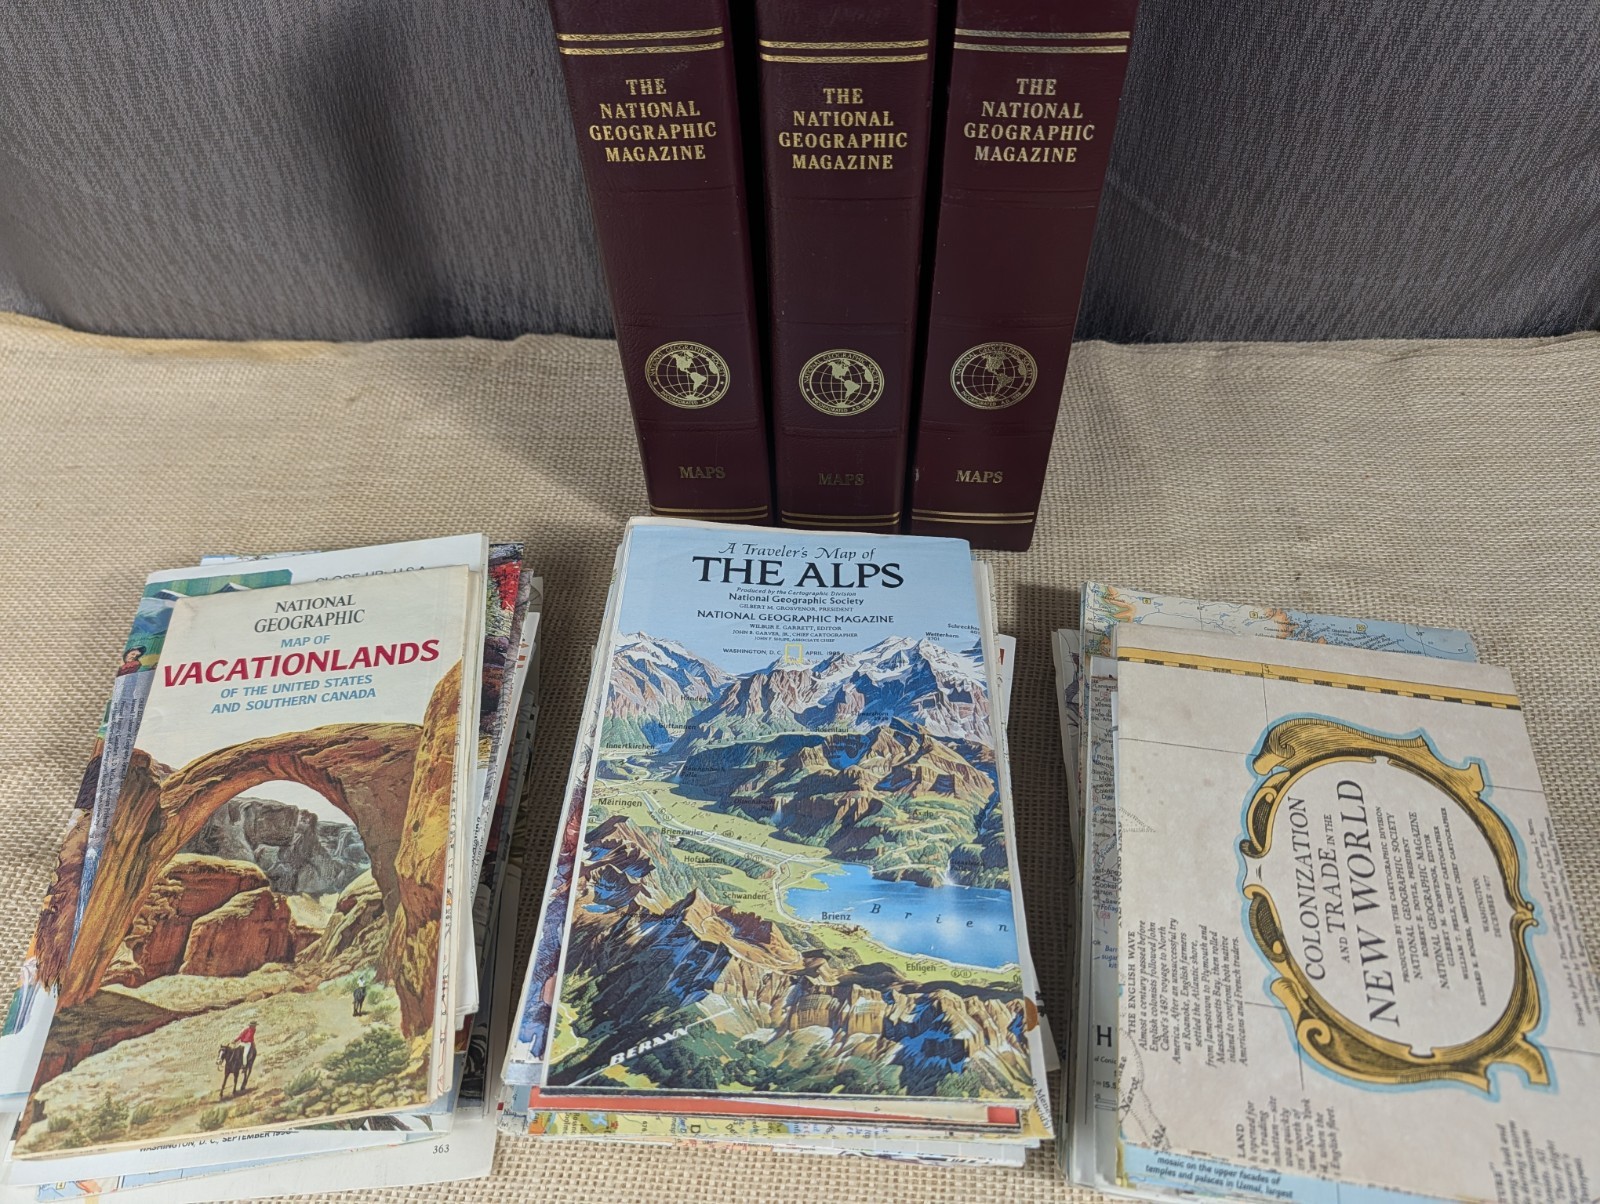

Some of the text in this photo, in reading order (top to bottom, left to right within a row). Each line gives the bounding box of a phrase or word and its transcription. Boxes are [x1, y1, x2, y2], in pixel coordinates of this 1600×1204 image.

[626, 79, 666, 95] THE
[823, 88, 863, 104] THE
[1016, 78, 1057, 96] THE
[599, 101, 700, 119] NATIONAL
[793, 111, 894, 127] NATIONAL
[981, 101, 1083, 119] NATIONAL
[589, 121, 717, 141] GEOGRAPHIC
[779, 132, 908, 149] GEOGRAPHIC
[963, 122, 1095, 141] GEOGRAPHIC
[605, 144, 706, 162] MAGAZINE
[792, 154, 893, 170] MAGAZINE
[974, 145, 1077, 163] MAGAZINE
[679, 466, 726, 479] MAPS
[819, 473, 864, 486] MAPS
[956, 469, 1003, 484] MAPS
[718, 542, 877, 564] A Traveler's Map of
[692, 555, 905, 588] THE ALPS
[729, 593, 865, 606] National Geographic Society
[736, 587, 767, 595] Produced
[275, 595, 356, 614] NATIONAL
[254, 610, 366, 634] GEOGRAPHIC
[697, 610, 895, 623] NATIONAL GEOGRAPHIC MAGAZINE
[280, 635, 331, 649] MAP OF
[164, 639, 440, 688] VACATIONLANDS
[220, 674, 373, 699] OF THE UNITED STATES
[211, 687, 377, 715] AND SOUTHERN CANADA
[598, 798, 643, 808] Meiringen
[722, 891, 766, 900] Schwanden
[1287, 796, 1326, 980] COLONIZATION
[1318, 813, 1351, 963] AND TRADE IN THE
[1376, 806, 1410, 984] PRODUCED BY THE CARTOGRAPHIC DIVISION
[1386, 812, 1423, 980] NATIONAL GEOGRAPHIC SOCIETY
[1402, 836, 1429, 958] ROBERT DOYLE, PRESIDENT
[1336, 779, 1400, 1027] NEW WORLD
[1409, 811, 1451, 990] NATIONAL GEOGRAPHIC MAGAZINE
[1424, 833, 1455, 967] GILBERT GROSVENOR, EDITOR
[821, 911, 851, 921] Brienz
[905, 963, 937, 973] Ebligen
[1127, 931, 1136, 1010] ENGLISH WAVE
[1136, 920, 1149, 1051] Almost century passed before
[1148, 922, 1161, 1053] English colonists followed John
[1158, 926, 1171, 1052] Cabot's 1497 voyage North
[1178, 933, 1191, 1040] Roanoke, English farmers
[1188, 940, 1203, 1048] settled Atlantic shore,
[1168, 931, 1181, 1064] America. After unsuccessful
[1200, 942, 1217, 1068] from Jamestown Plymouth
[1208, 931, 1226, 1064] Massachusetts Bay, then rolled
[1219, 936, 1237, 1063] inland confront both native
[1230, 937, 1248, 1066] Americans French traders.
[433, 1144, 450, 1154] 363
[1236, 1123, 1246, 1159] LAND
